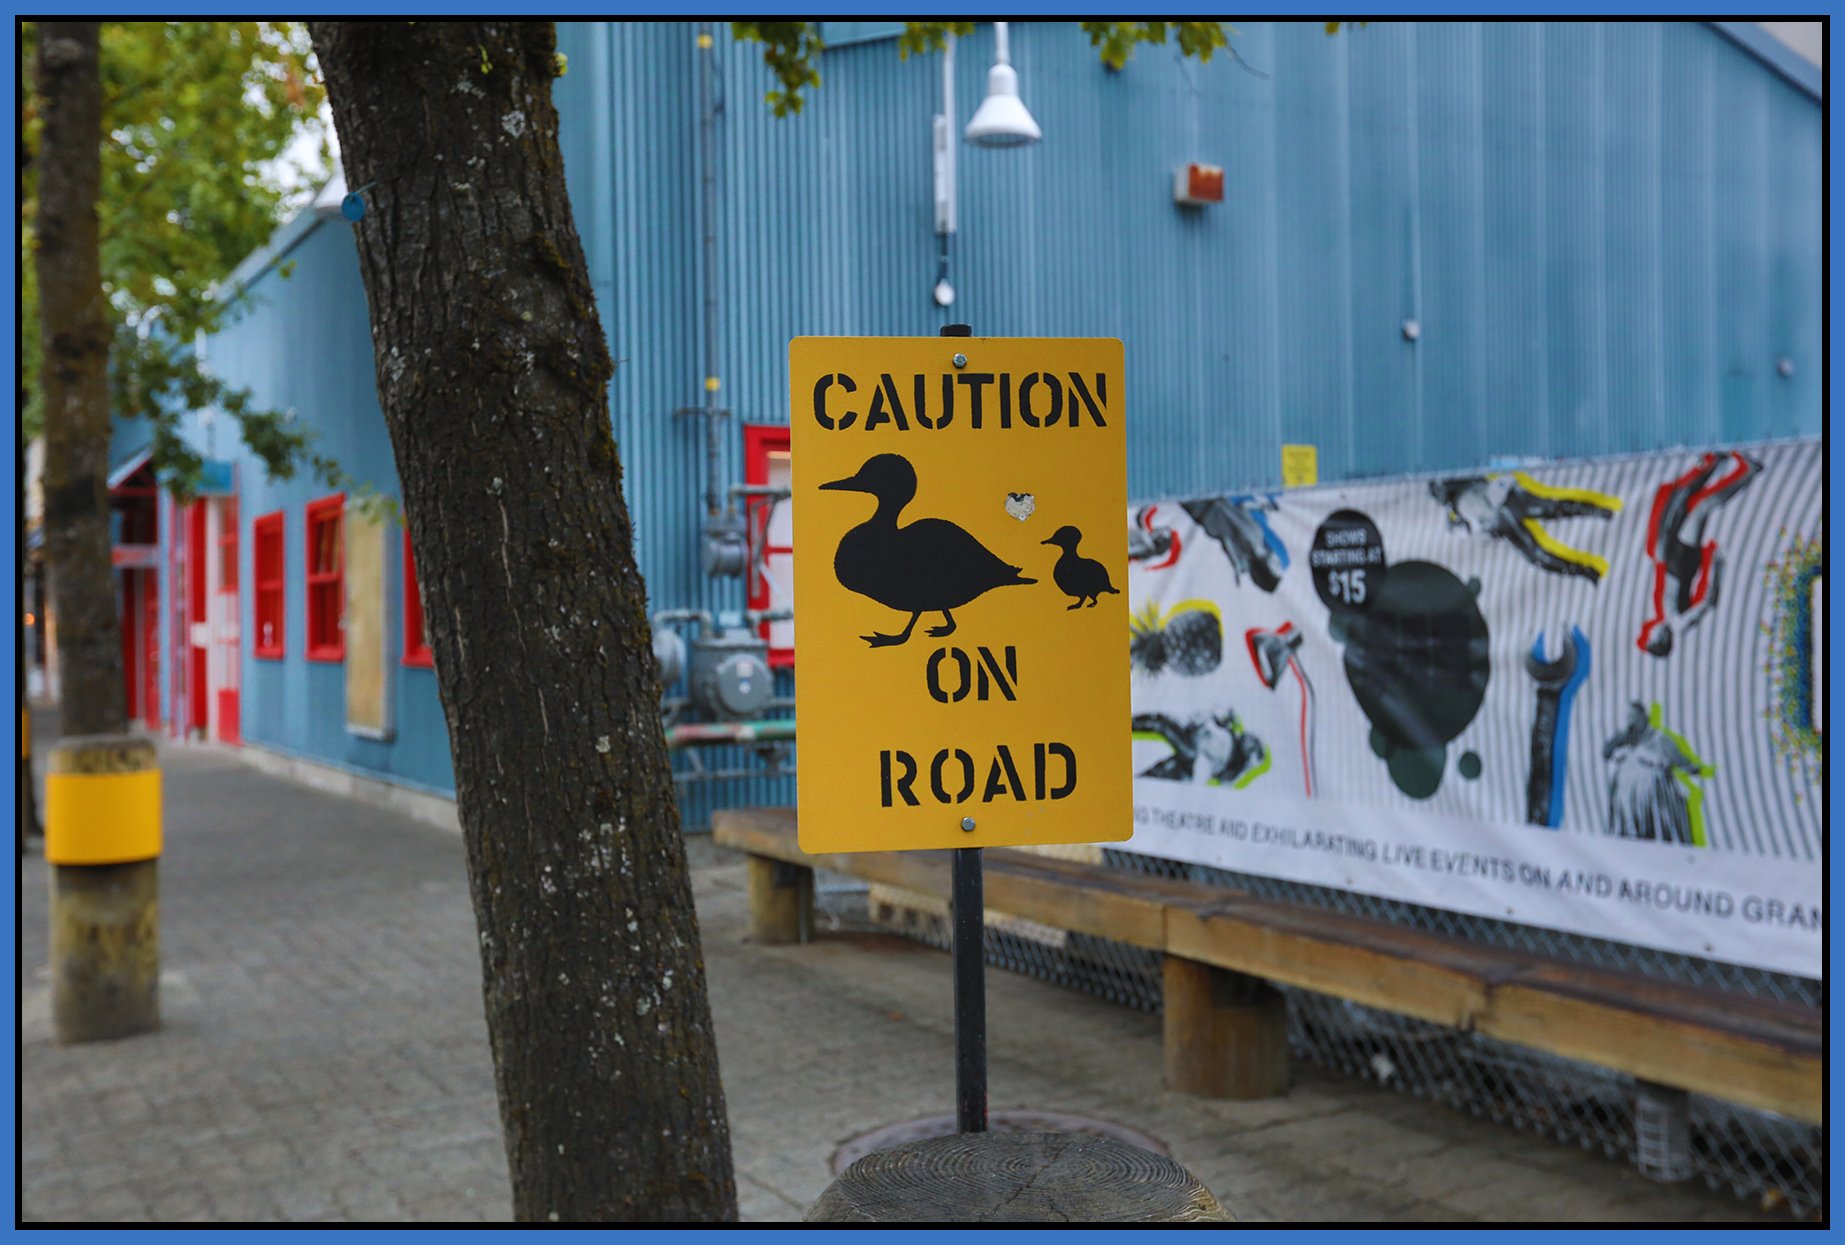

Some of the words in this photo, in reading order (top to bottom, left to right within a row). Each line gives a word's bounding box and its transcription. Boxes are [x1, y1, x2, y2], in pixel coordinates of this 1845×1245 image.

[813, 372, 1108, 431] CAUTION
[1311, 547, 1365, 567] STARTING
[1367, 545, 1382, 563] AT
[1325, 528, 1368, 548] SHOWS
[1328, 568, 1367, 605] $15
[926, 646, 1017, 703] ON
[880, 742, 1077, 807] ROAD
[1152, 806, 1216, 836] THEATRE
[1219, 817, 1249, 842] AND
[1251, 822, 1378, 862] EXHILARATING
[1382, 842, 1430, 866] LIVE
[1431, 848, 1516, 885] EVENTS
[1518, 860, 1552, 889] ON
[1555, 869, 1614, 899] AND
[1617, 877, 1736, 919] AROUND
